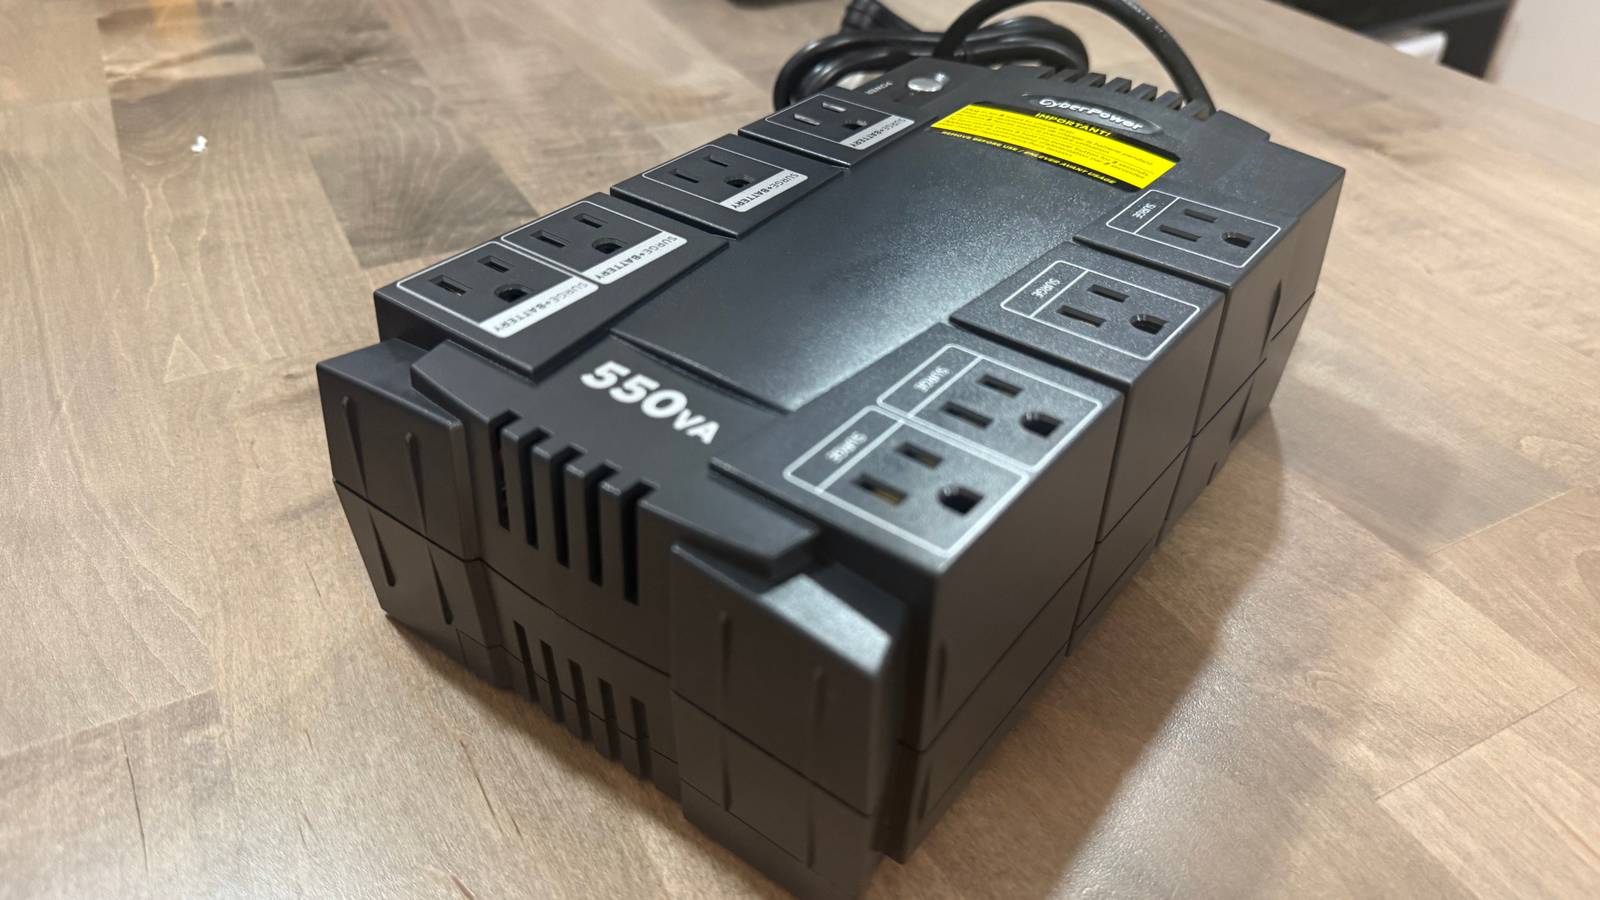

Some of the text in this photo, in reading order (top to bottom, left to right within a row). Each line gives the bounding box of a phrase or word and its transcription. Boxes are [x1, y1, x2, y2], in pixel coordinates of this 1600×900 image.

[1035, 112, 1112, 137] IMPORTANT!
[1039, 97, 1143, 130] CyberPower
[849, 118, 907, 148] SURGE+BATTERY
[941, 131, 972, 140] REMOVE
[972, 137, 1003, 147] BEFORE
[730, 172, 800, 209] SURGE+BATTERY
[1132, 202, 1157, 220] SURGE
[595, 235, 679, 280] SURGE+BATTERY
[1031, 278, 1060, 298] SURGE
[493, 281, 589, 332] SURGE+BATTERY
[913, 365, 950, 393] SURGE
[579, 359, 720, 445] 550VA
[825, 430, 868, 464] SURGE
